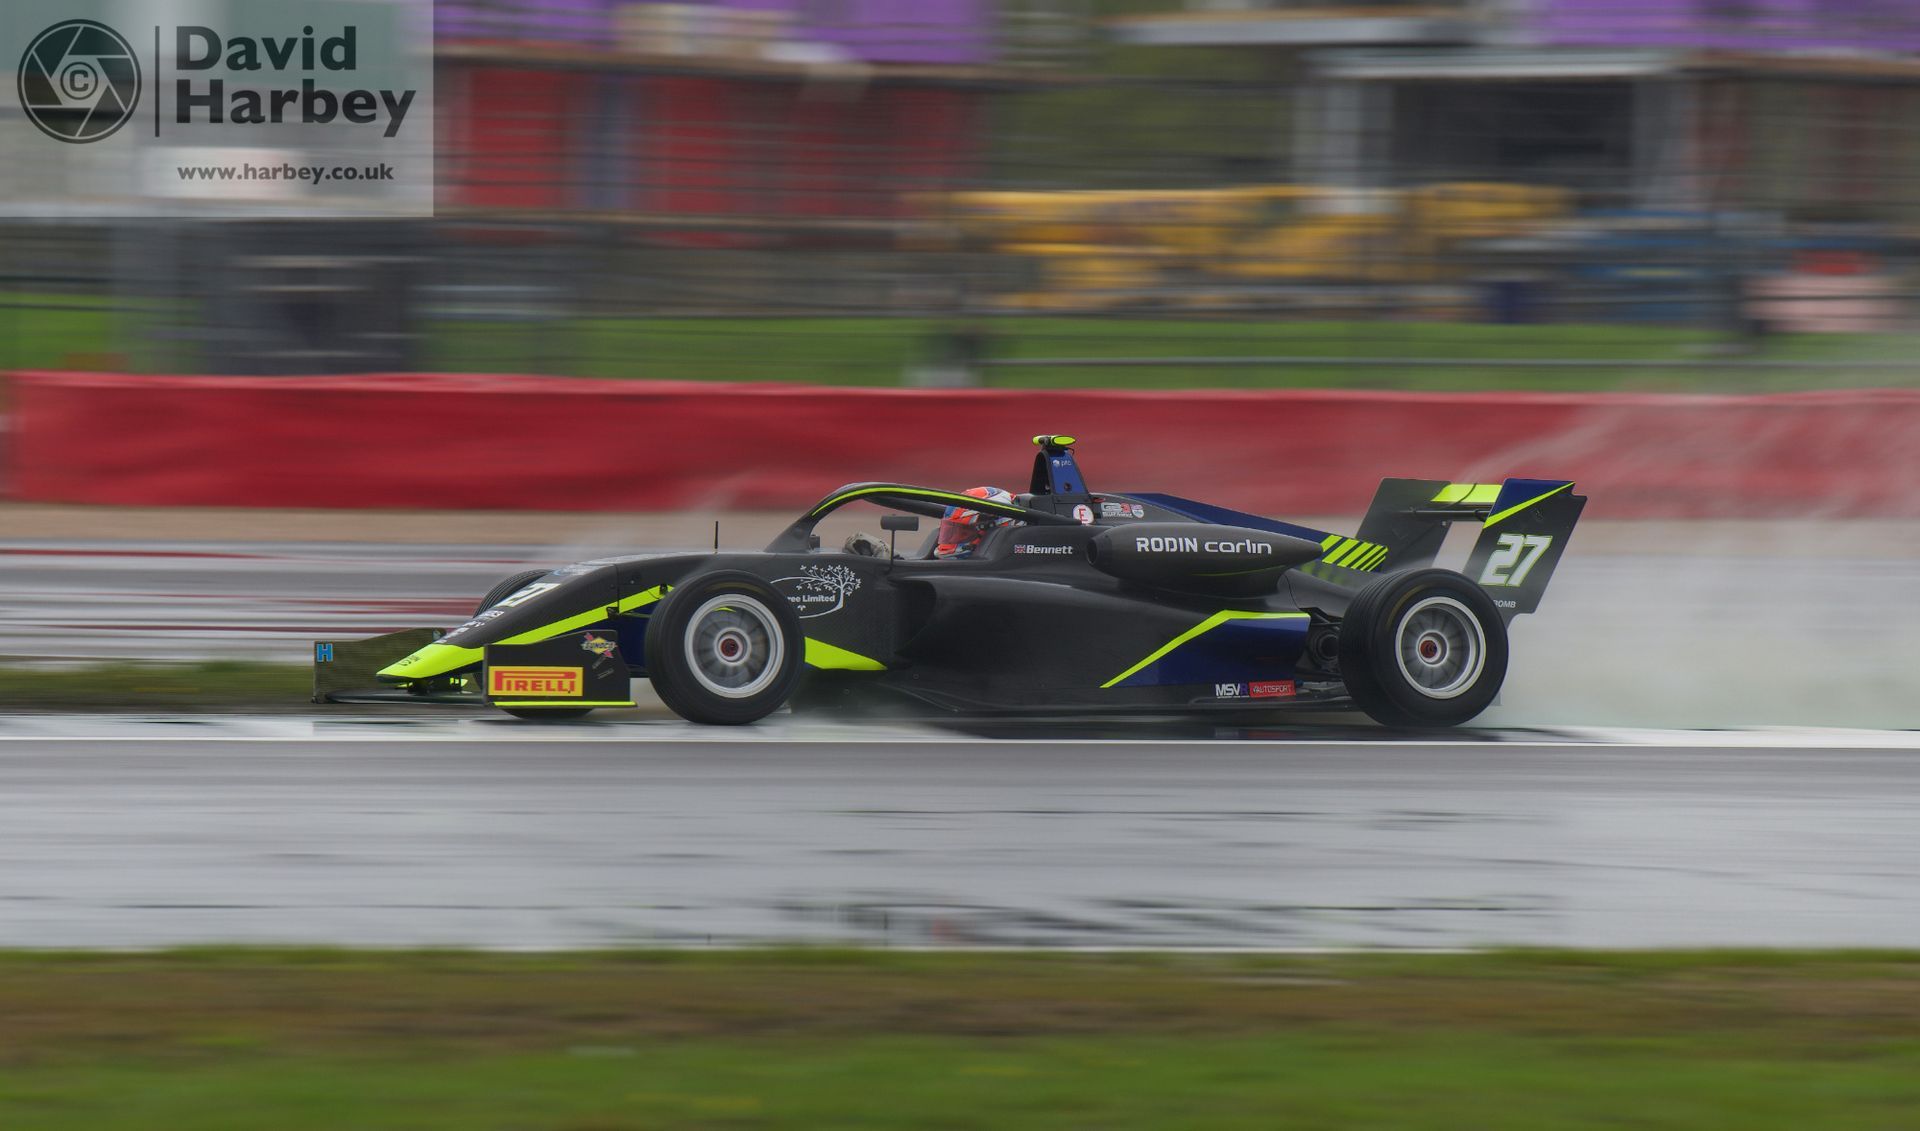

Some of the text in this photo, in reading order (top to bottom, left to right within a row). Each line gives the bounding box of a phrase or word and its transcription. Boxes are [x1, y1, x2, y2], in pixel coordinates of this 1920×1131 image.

[1026, 544, 1073, 555] Bennett
[1135, 537, 1272, 554] RODIN carlin
[1479, 533, 1552, 587] 27
[802, 594, 836, 603] Limited
[316, 643, 333, 662] H
[494, 671, 577, 692] PIRELLI
